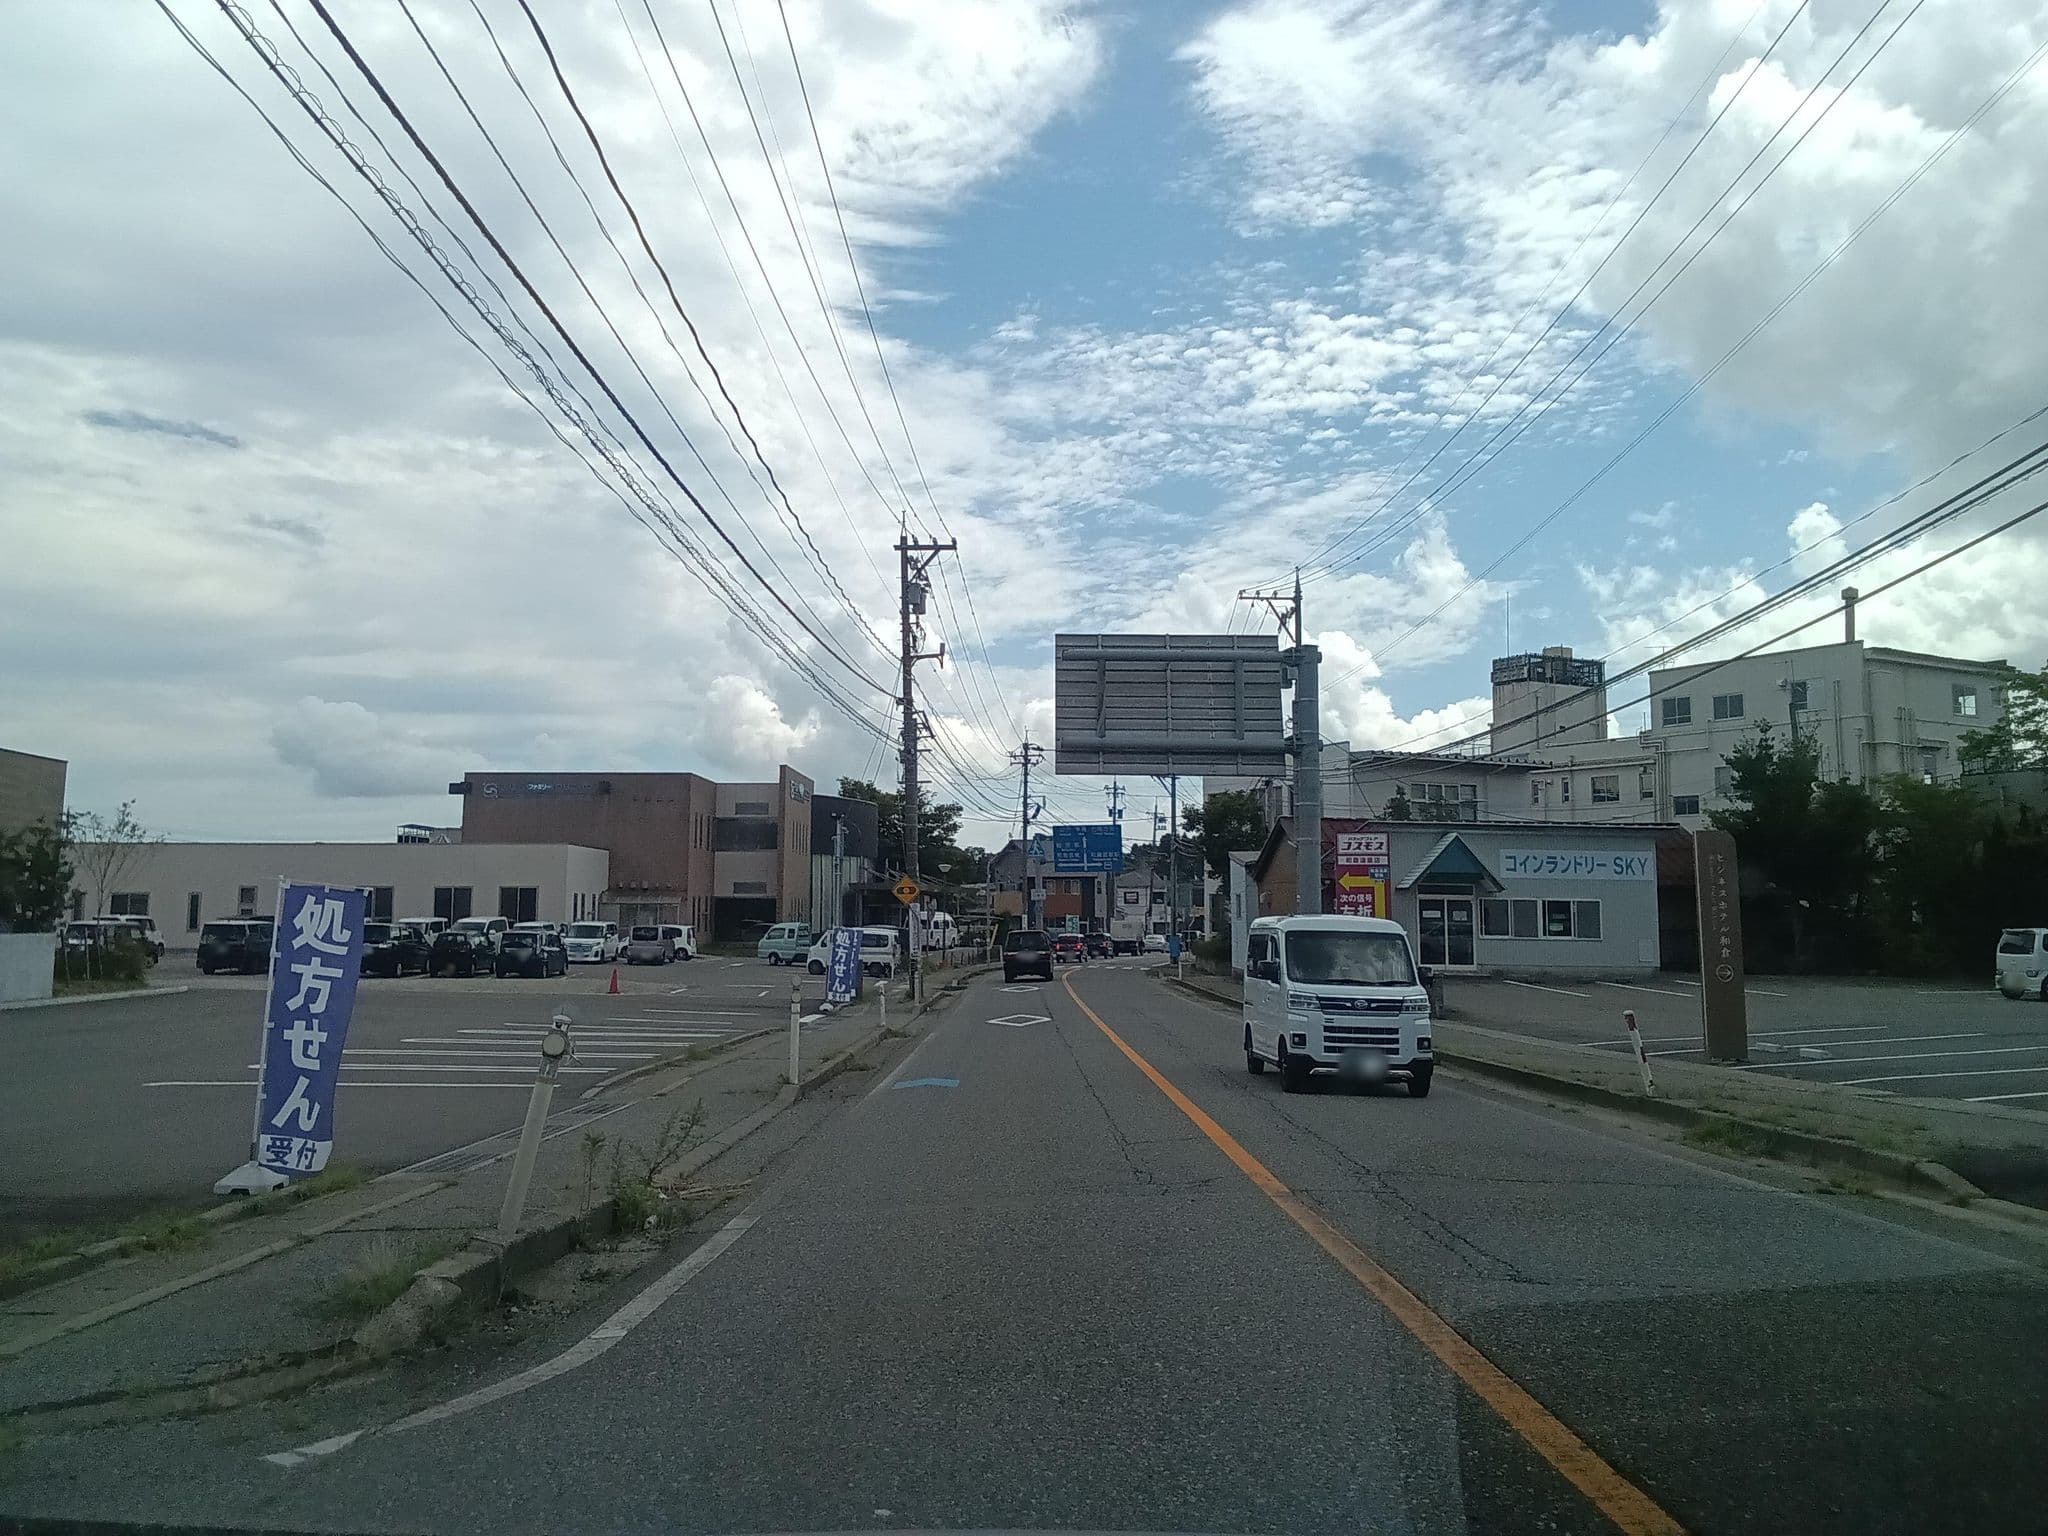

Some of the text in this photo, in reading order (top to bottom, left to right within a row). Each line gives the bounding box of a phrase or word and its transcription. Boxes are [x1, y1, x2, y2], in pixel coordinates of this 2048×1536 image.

[1341, 842, 1384, 850] コスモス
[1505, 855, 1647, 876] コインランドリー SKY
[1340, 894, 1372, 903] 次の信号
[833, 930, 850, 992] 処方せん
[271, 895, 351, 1132] 処方せん
[266, 1136, 317, 1170] 受付
